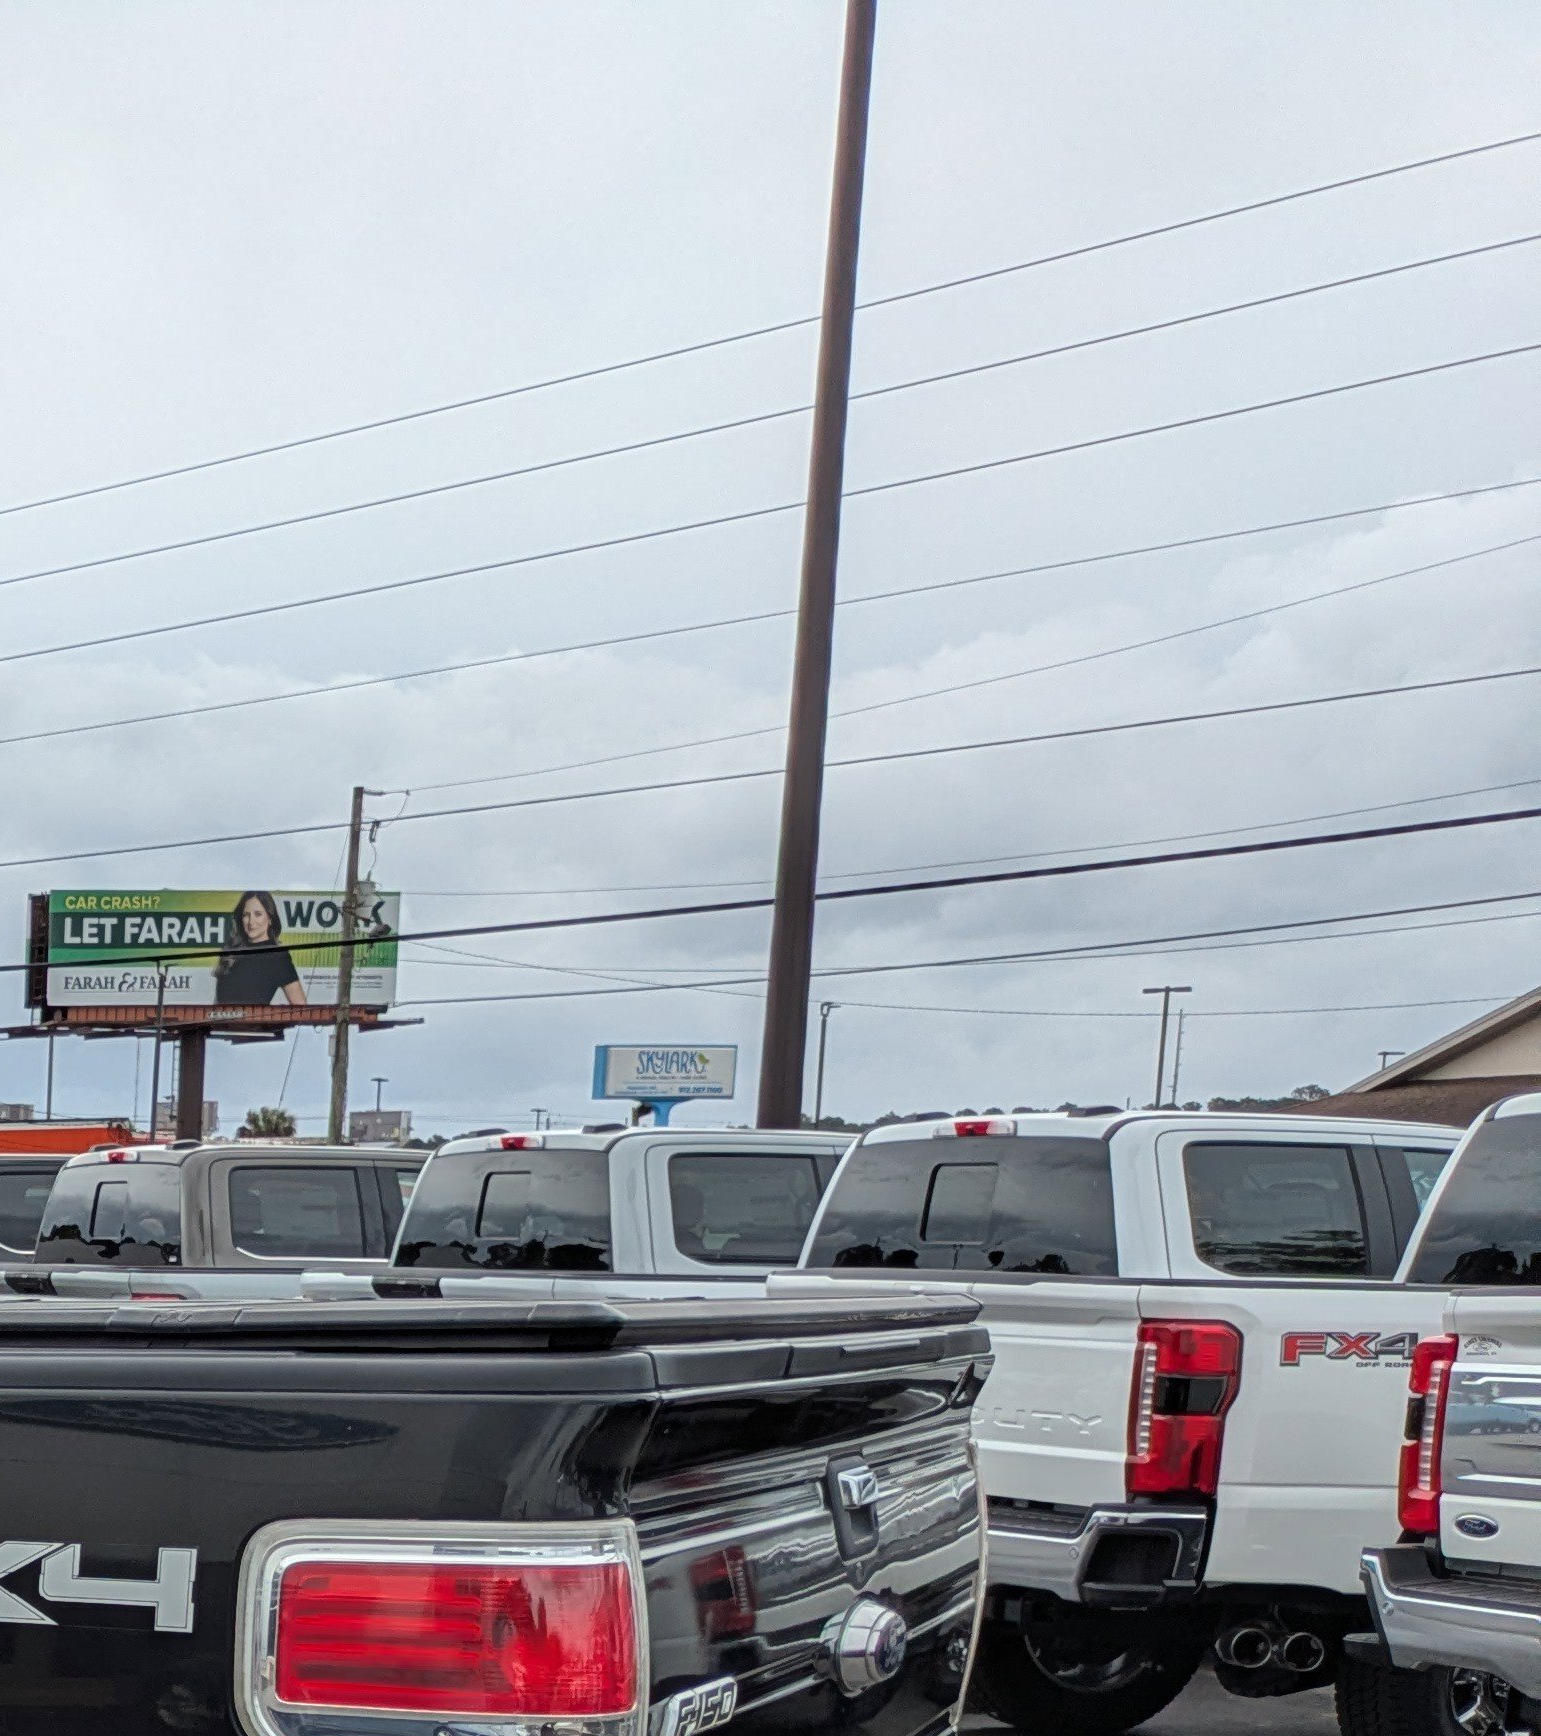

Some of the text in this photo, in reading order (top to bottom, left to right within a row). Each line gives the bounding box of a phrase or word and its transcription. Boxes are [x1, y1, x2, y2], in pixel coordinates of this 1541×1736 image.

[65, 896, 161, 910] CAR CRASH?
[63, 900, 387, 944] LET FARAH WOK
[63, 976, 116, 990] FARAH
[118, 972, 138, 992] &
[636, 1050, 707, 1075] SKYLARK
[1279, 1331, 1419, 1367] FX4
